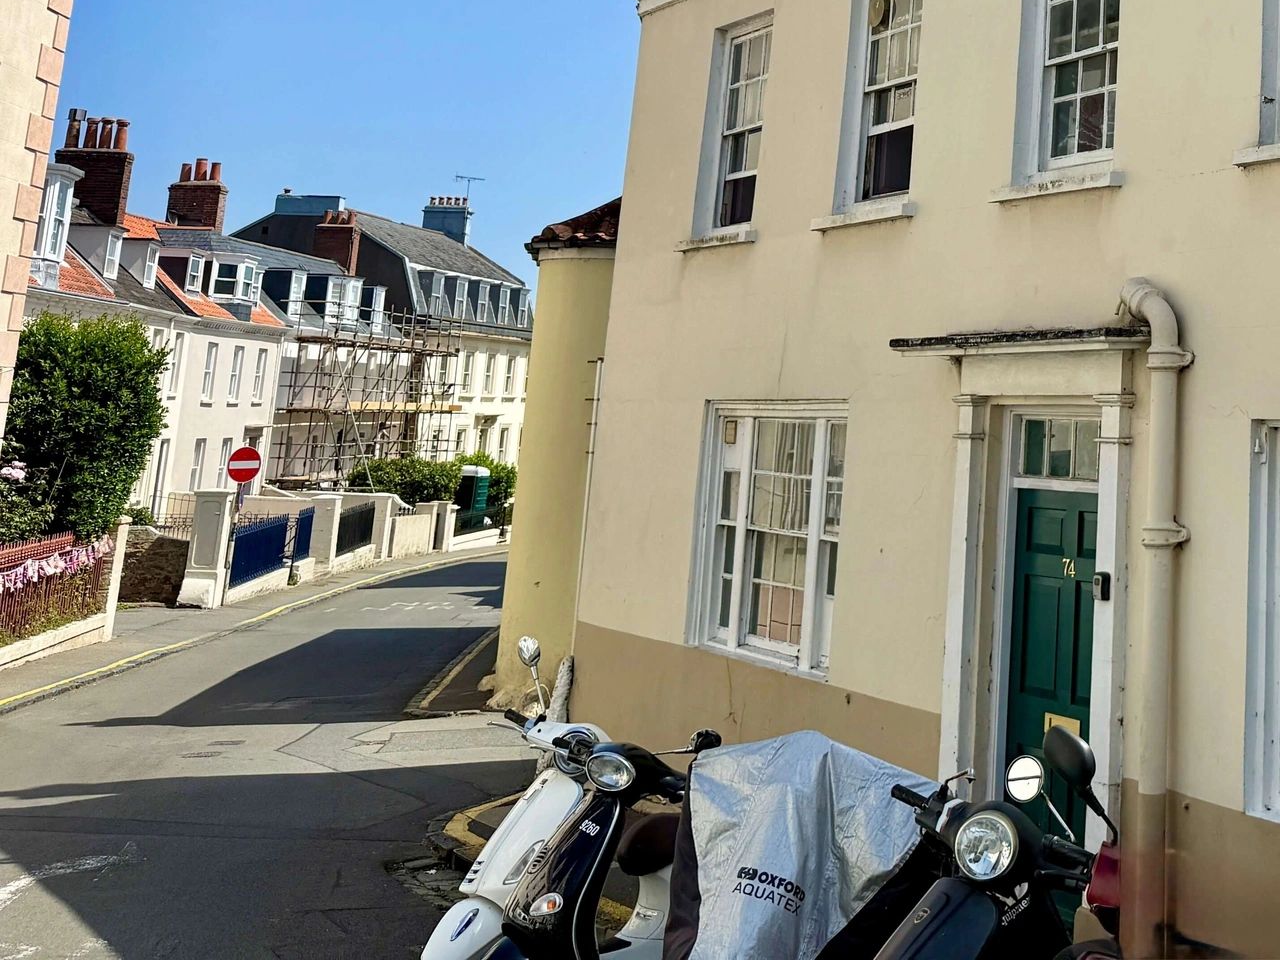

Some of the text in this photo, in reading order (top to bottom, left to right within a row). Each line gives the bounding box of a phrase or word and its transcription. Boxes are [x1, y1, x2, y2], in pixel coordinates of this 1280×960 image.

[1062, 558, 1076, 578] 74
[732, 881, 801, 917] AQUATEX
[758, 871, 806, 903] OXFORD
